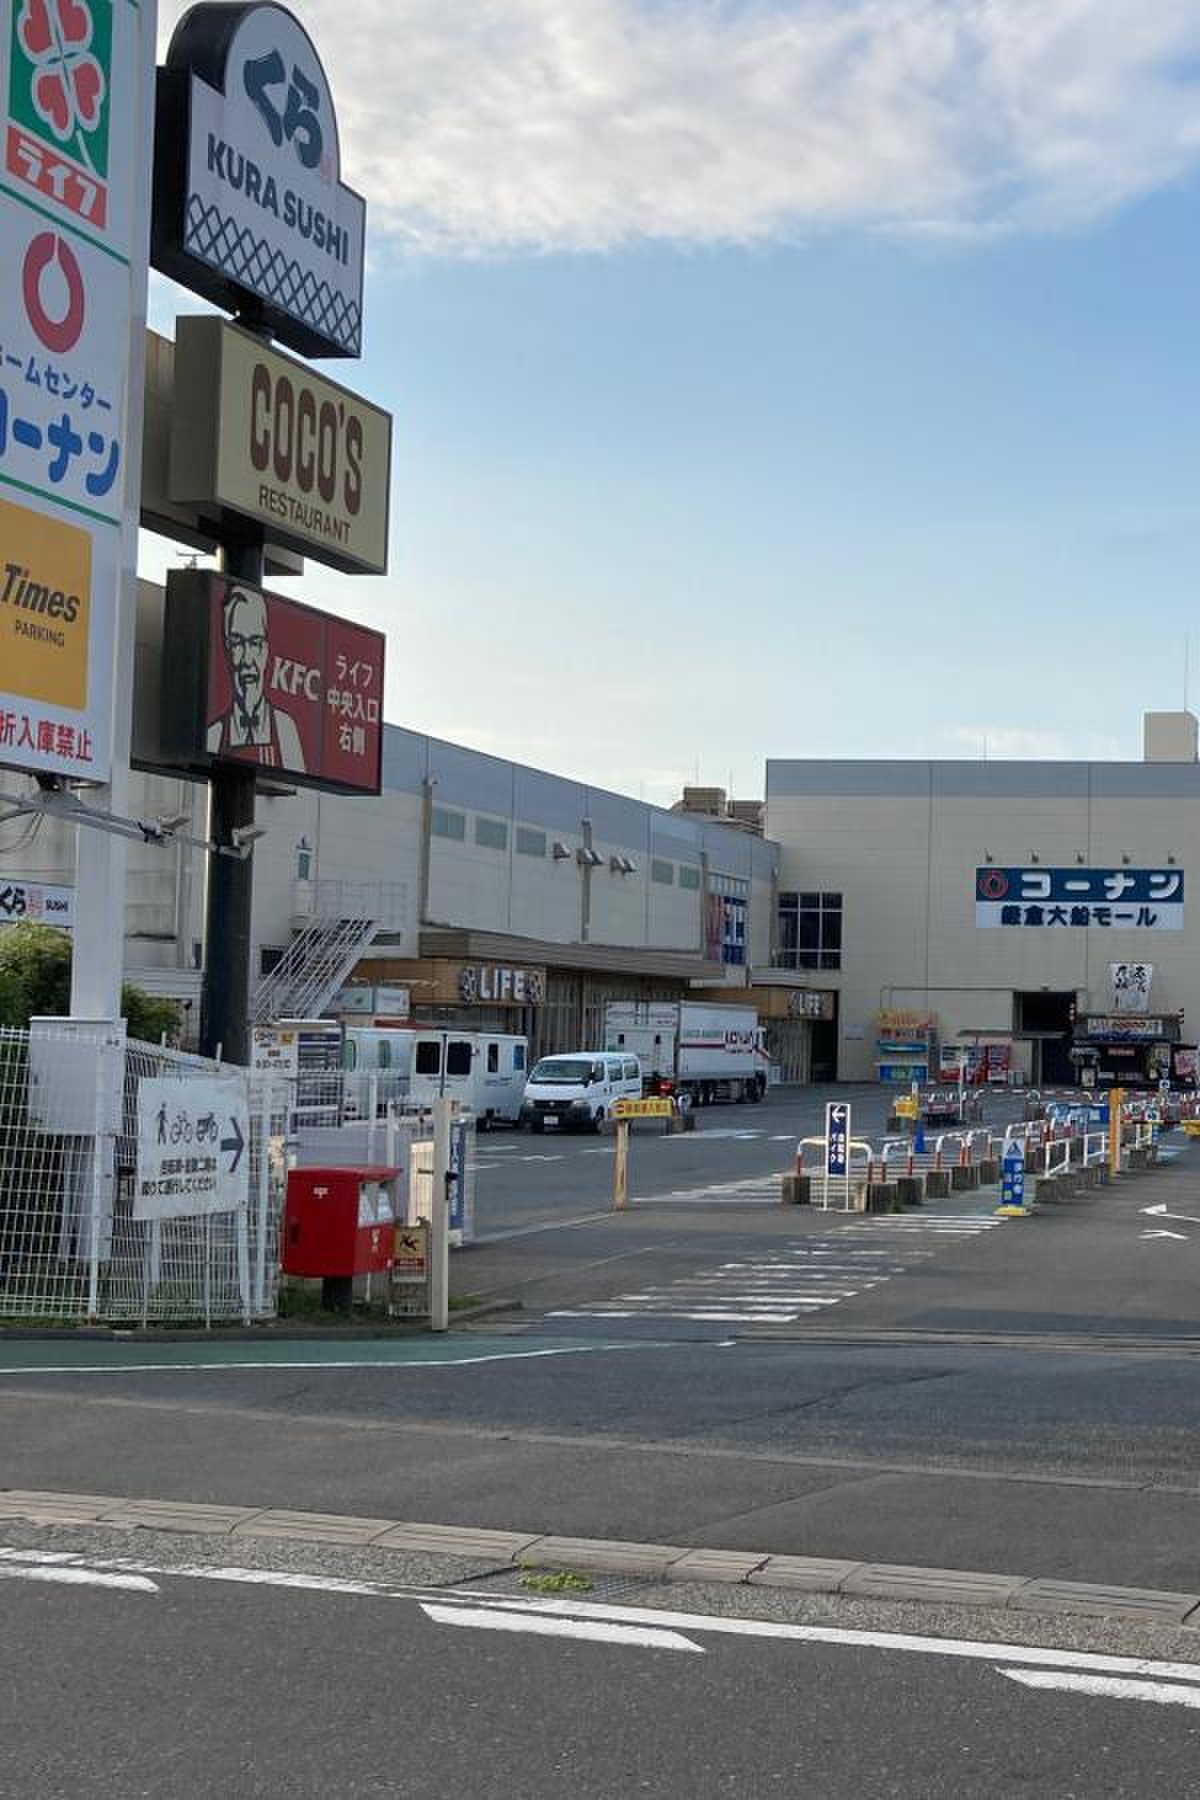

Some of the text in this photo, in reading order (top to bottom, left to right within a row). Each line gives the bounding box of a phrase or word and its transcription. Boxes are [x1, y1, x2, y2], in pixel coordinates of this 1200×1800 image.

[243, 49, 323, 169] くら
[17, 138, 98, 220] ライフ
[207, 133, 349, 266] KURA SUSHI
[0, 345, 112, 410] ームセンター
[251, 363, 363, 516] COCO'S
[259, 484, 351, 545] RESTAURANT
[1, 562, 81, 623] Times
[15, 619, 66, 649] PARKING
[271, 656, 321, 701] KFC
[336, 655, 373, 689] ライフ
[327, 685, 379, 723] 中央入口
[1021, 872, 1180, 900] コーナン
[1001, 904, 1158, 927] 鎌倉大船モール
[480, 965, 528, 1002] LIFE
